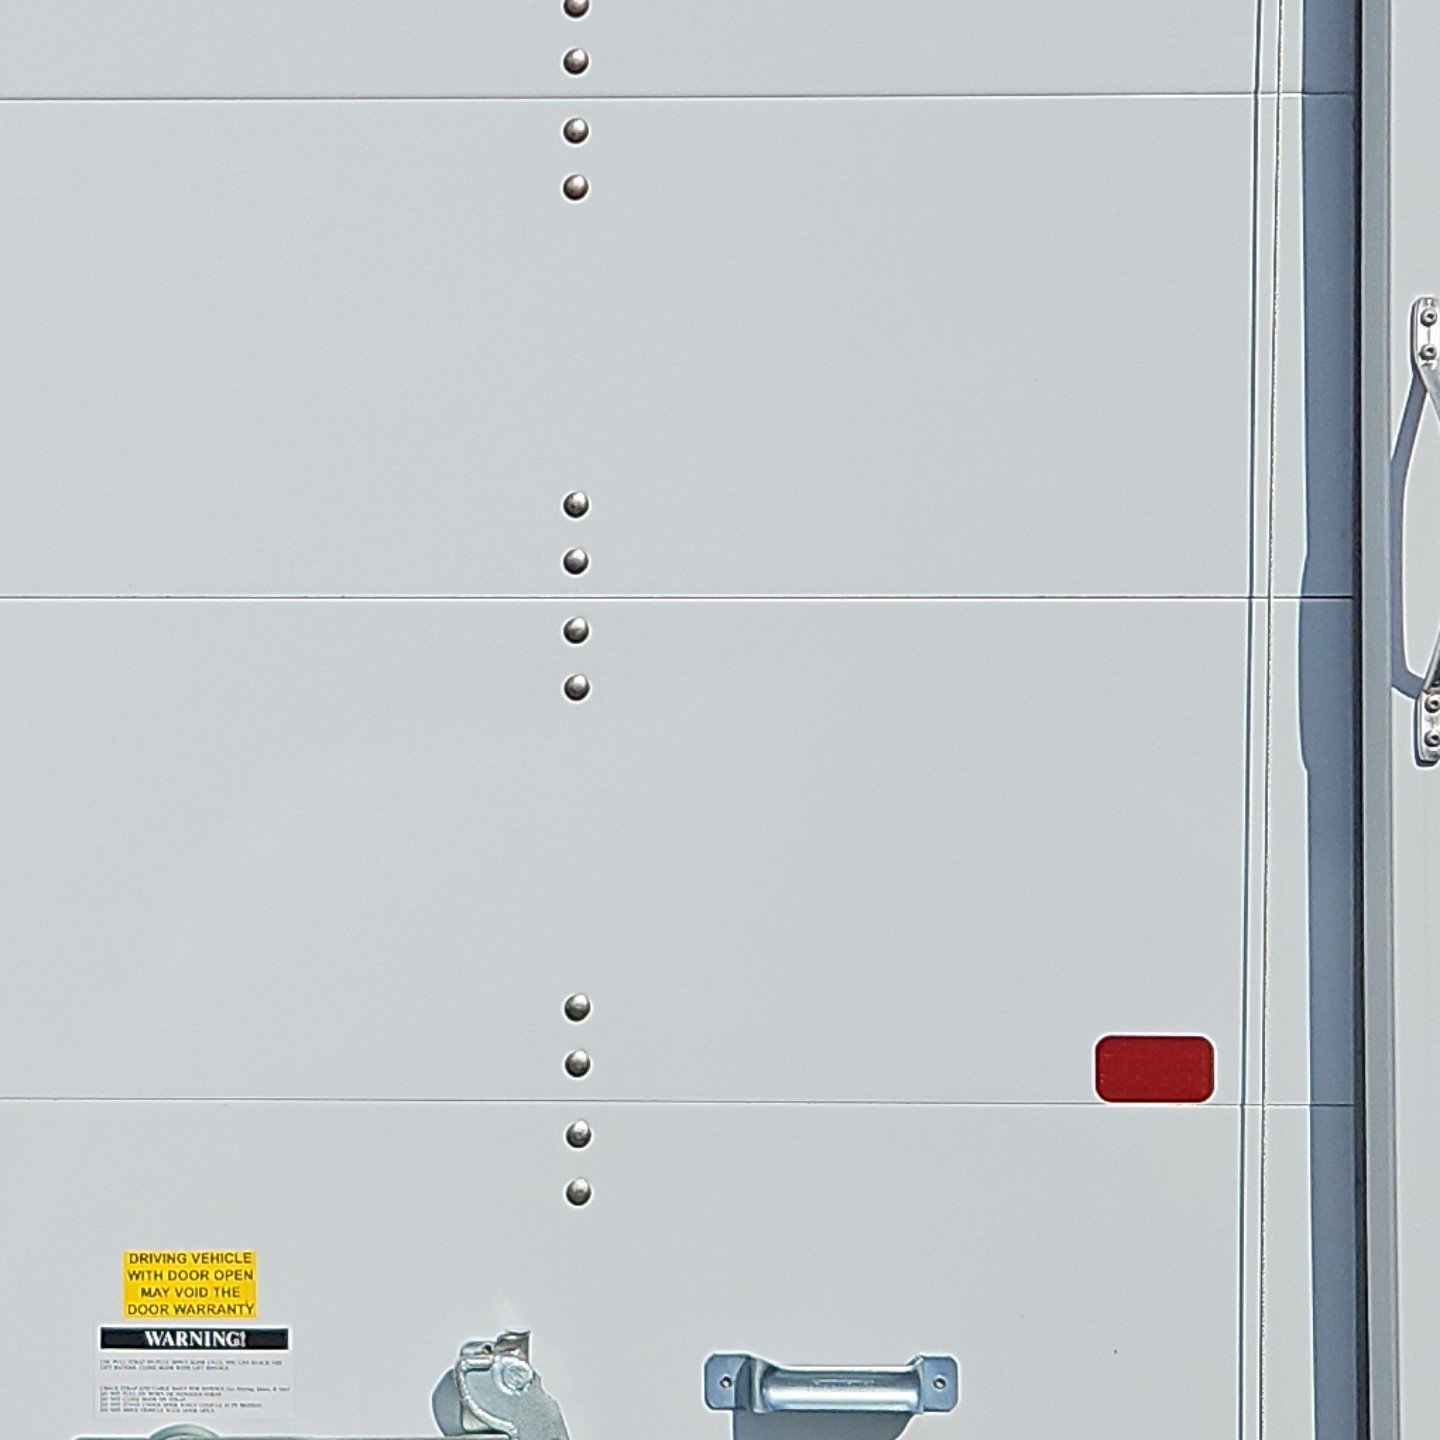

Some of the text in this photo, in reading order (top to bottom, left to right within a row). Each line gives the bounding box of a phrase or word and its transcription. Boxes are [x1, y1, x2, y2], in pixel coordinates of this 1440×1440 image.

[129, 1252, 252, 1264] DRIVING VEHICLE
[128, 1269, 253, 1281] WITH DOOR OPEN
[140, 1286, 240, 1298] MAY VOID THE
[128, 1303, 255, 1315] DOOR WARRANTY
[144, 1330, 247, 1348] WARNING!
